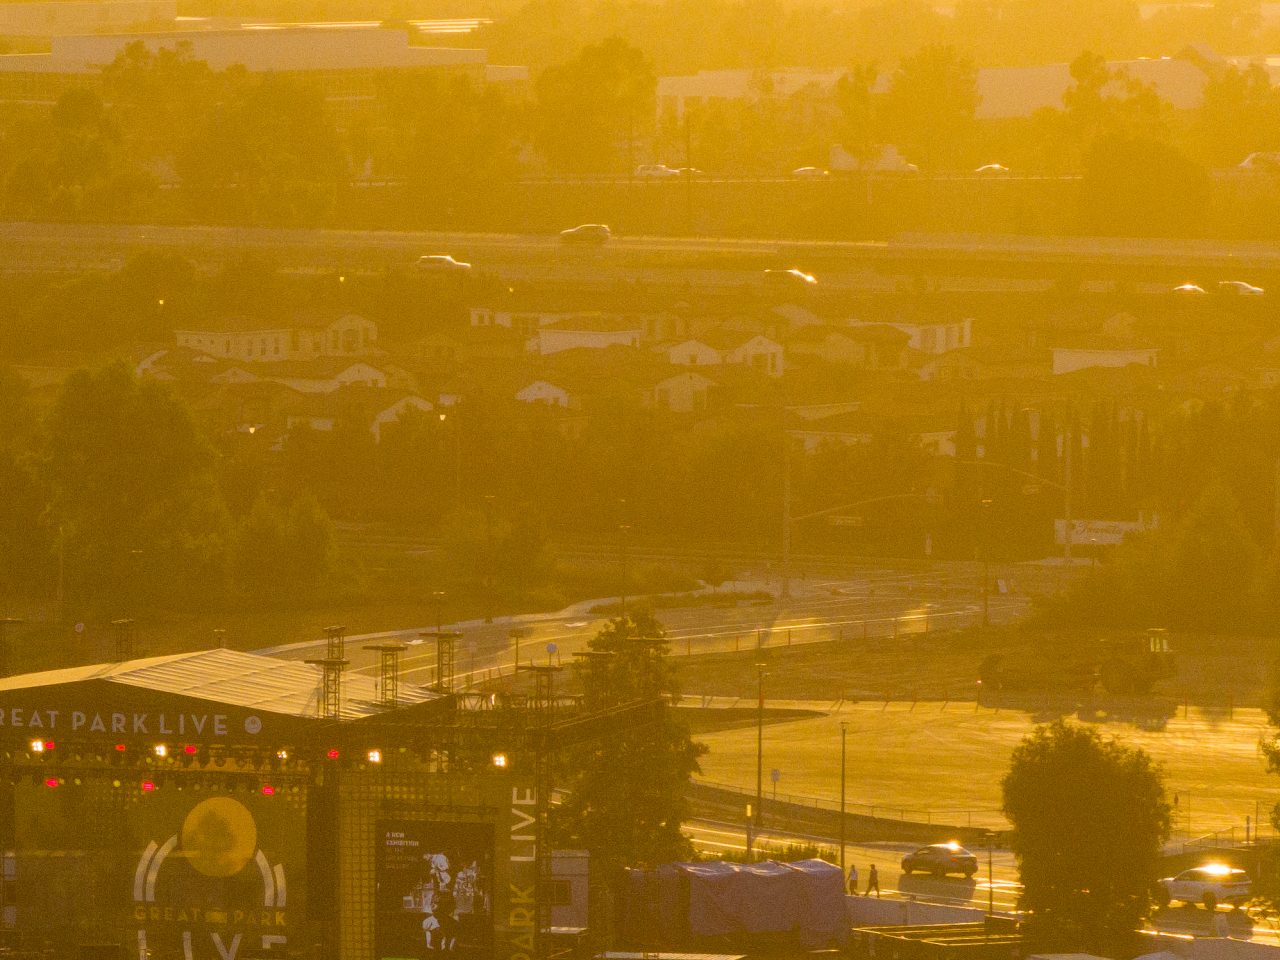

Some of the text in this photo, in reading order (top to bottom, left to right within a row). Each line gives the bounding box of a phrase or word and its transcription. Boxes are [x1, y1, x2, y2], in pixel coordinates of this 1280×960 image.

[72, 711, 148, 733] PARK
[159, 714, 228, 735] LIVE
[510, 786, 537, 862] LIVE
